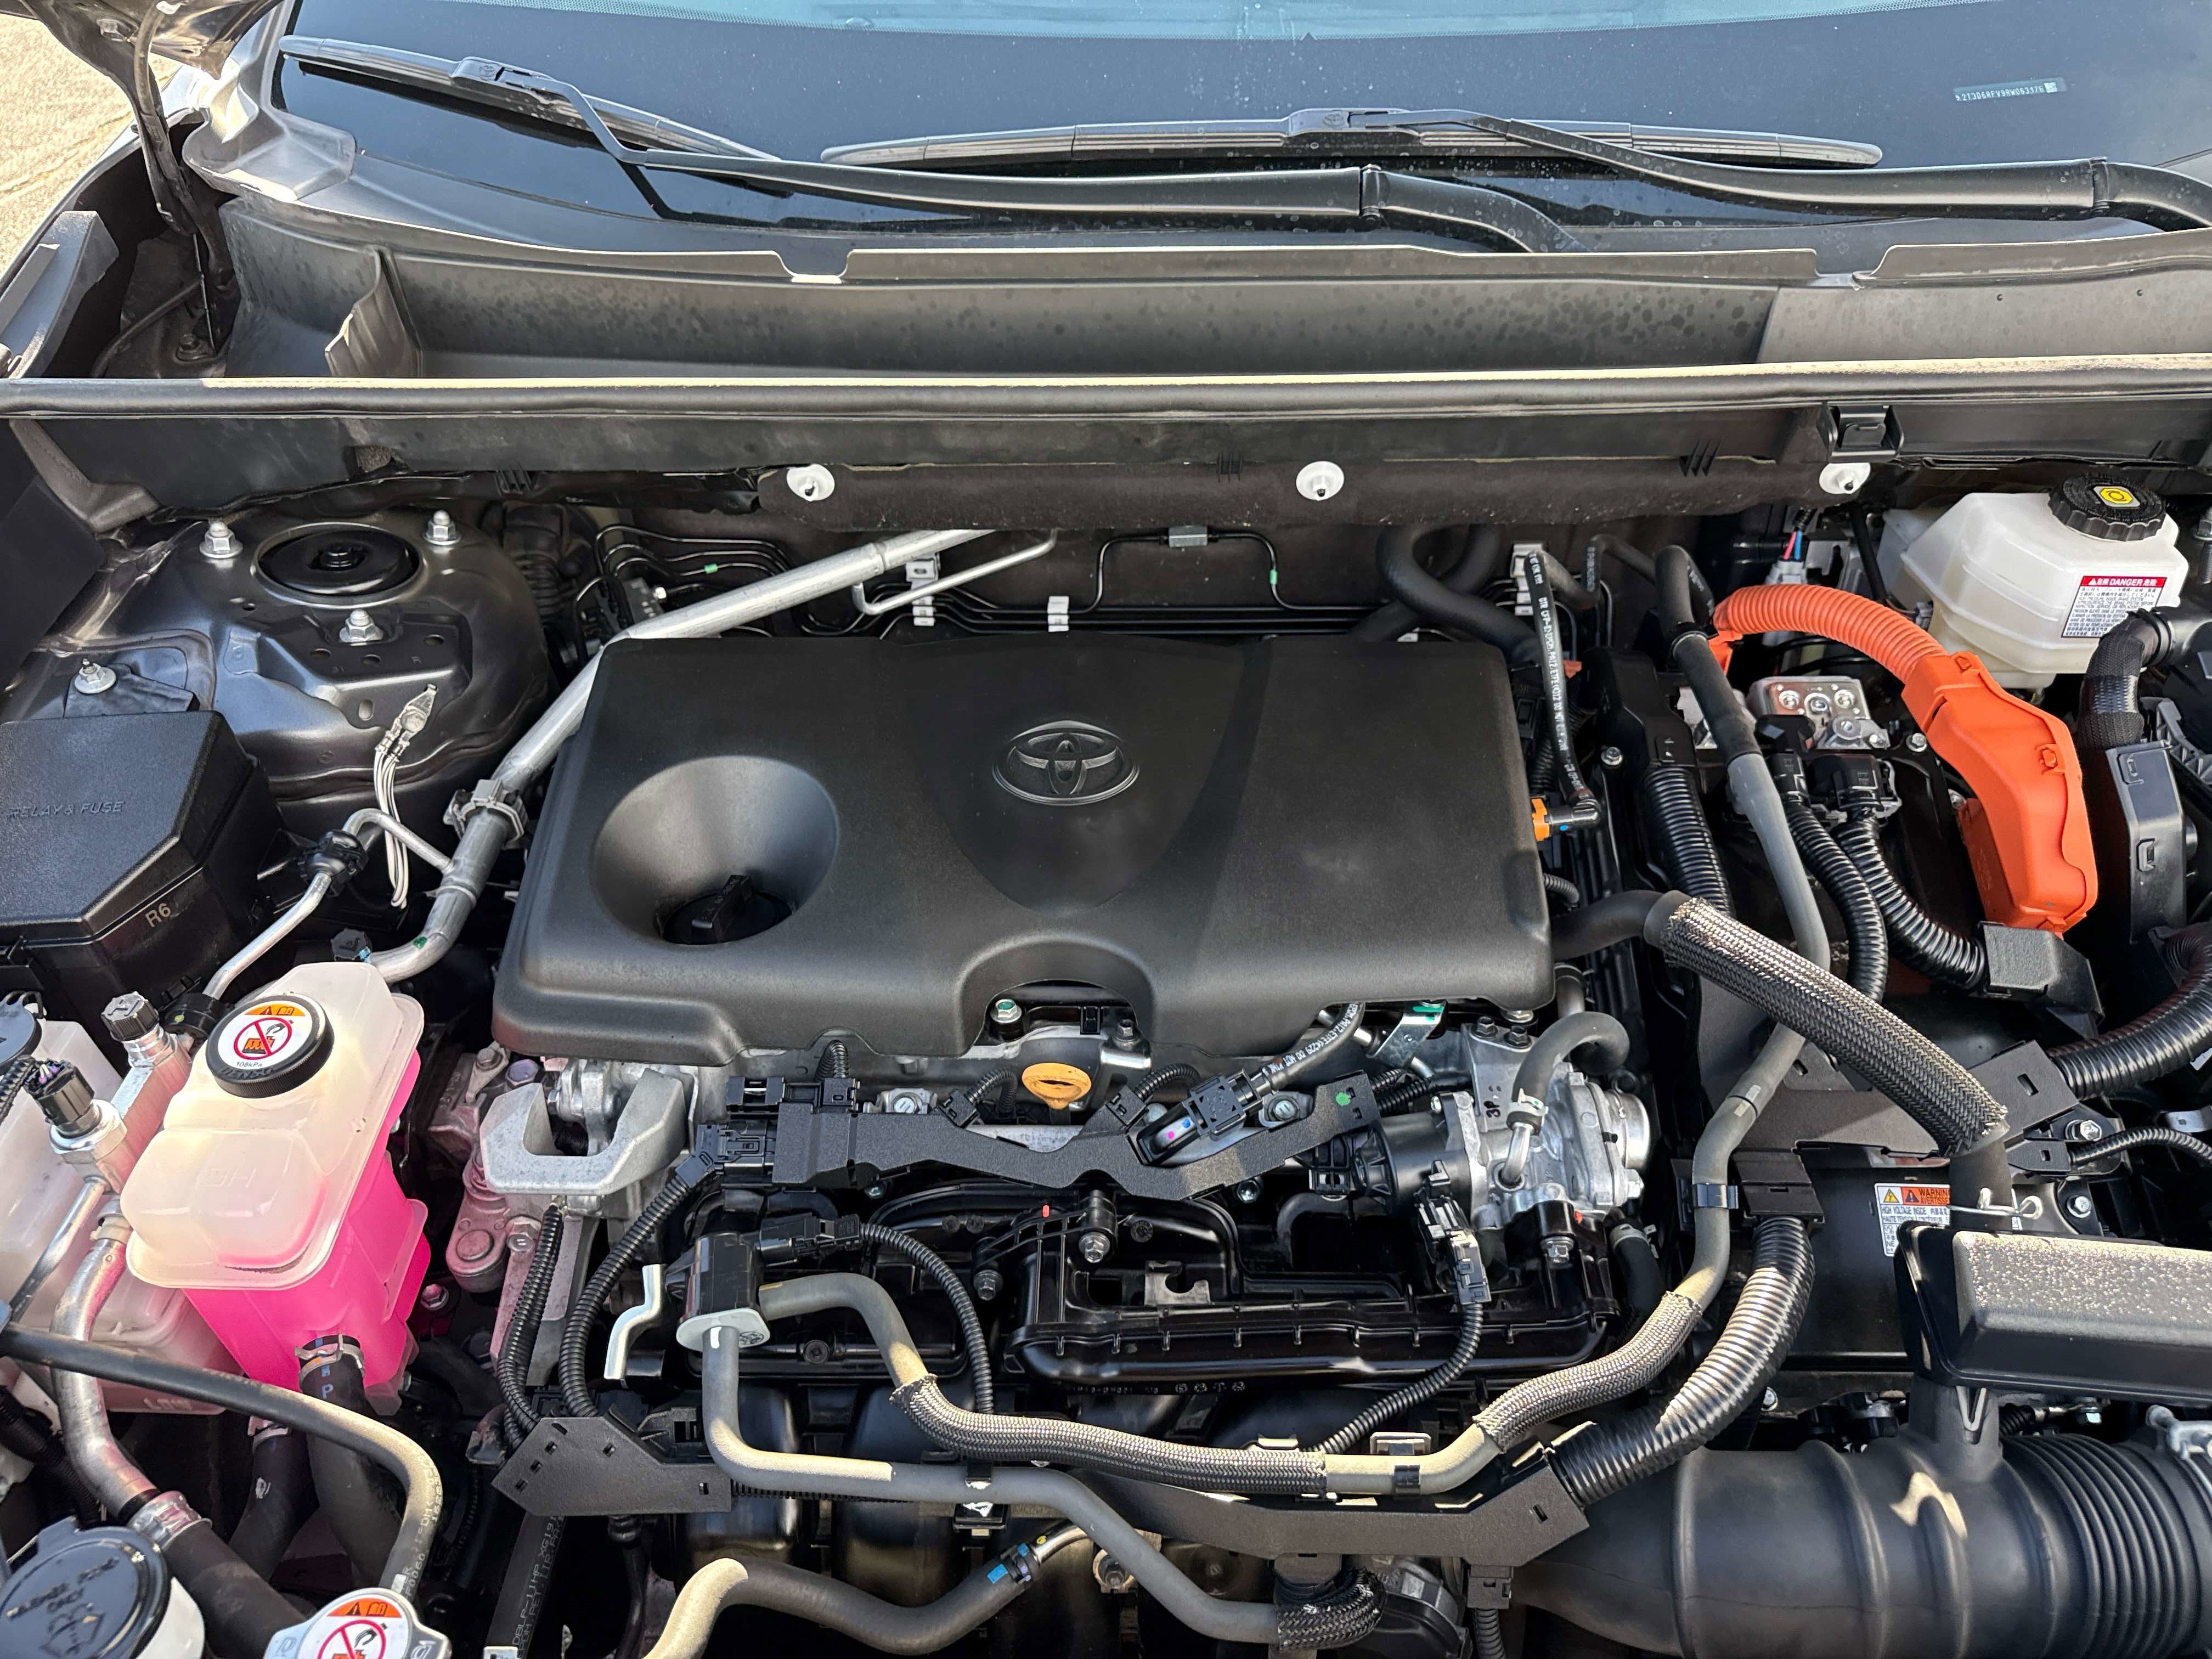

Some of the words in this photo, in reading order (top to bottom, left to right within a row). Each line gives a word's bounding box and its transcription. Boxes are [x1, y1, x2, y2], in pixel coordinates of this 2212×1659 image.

[8, 804, 60, 819] RELAY
[64, 804, 76, 816] &
[81, 800, 126, 814] FUSE
[144, 902, 172, 928] R6
[1918, 1188, 1950, 1197] WARNIN
[1920, 1197, 1950, 1205] AVERTISSE
[1881, 1206, 1891, 1214] HIGH
[1892, 1206, 1912, 1215] VOLTAGE
[1912, 1206, 1927, 1215] INSIDE
